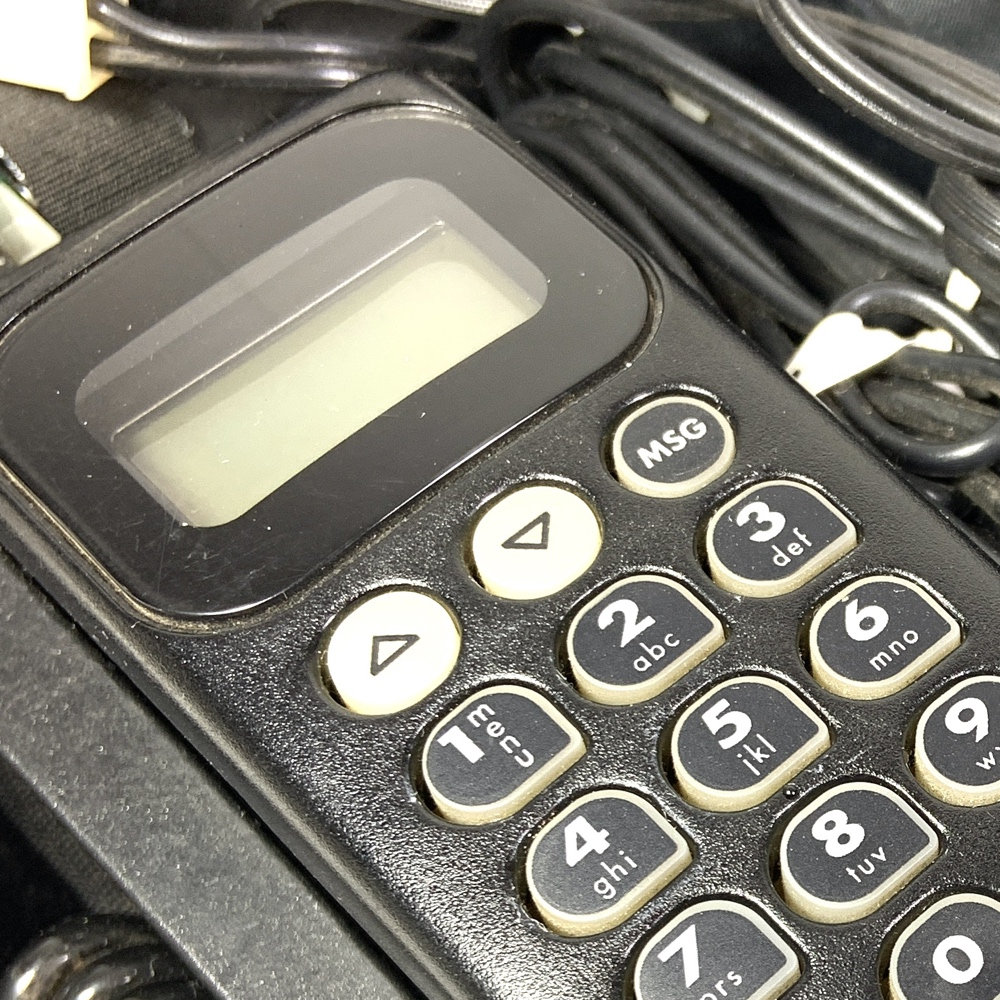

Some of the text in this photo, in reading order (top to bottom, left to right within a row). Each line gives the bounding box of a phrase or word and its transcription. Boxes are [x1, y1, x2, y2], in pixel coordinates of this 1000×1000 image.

[636, 417, 707, 469] MSG
[735, 501, 786, 543] 3
[772, 527, 813, 567] def
[597, 599, 656, 648] 2
[845, 599, 889, 642] 6
[633, 633, 681, 672] abc
[869, 630, 919, 671] mno
[466, 703, 535, 768] menu
[701, 698, 752, 750] 5
[944, 697, 989, 743] 9
[436, 725, 485, 764] 1
[736, 733, 777, 776] jkl
[564, 815, 611, 867] 4
[811, 809, 865, 858] 8
[593, 850, 638, 899] ghi
[845, 846, 887, 883] tuv
[657, 924, 700, 988] 7
[932, 935, 984, 986] 0
